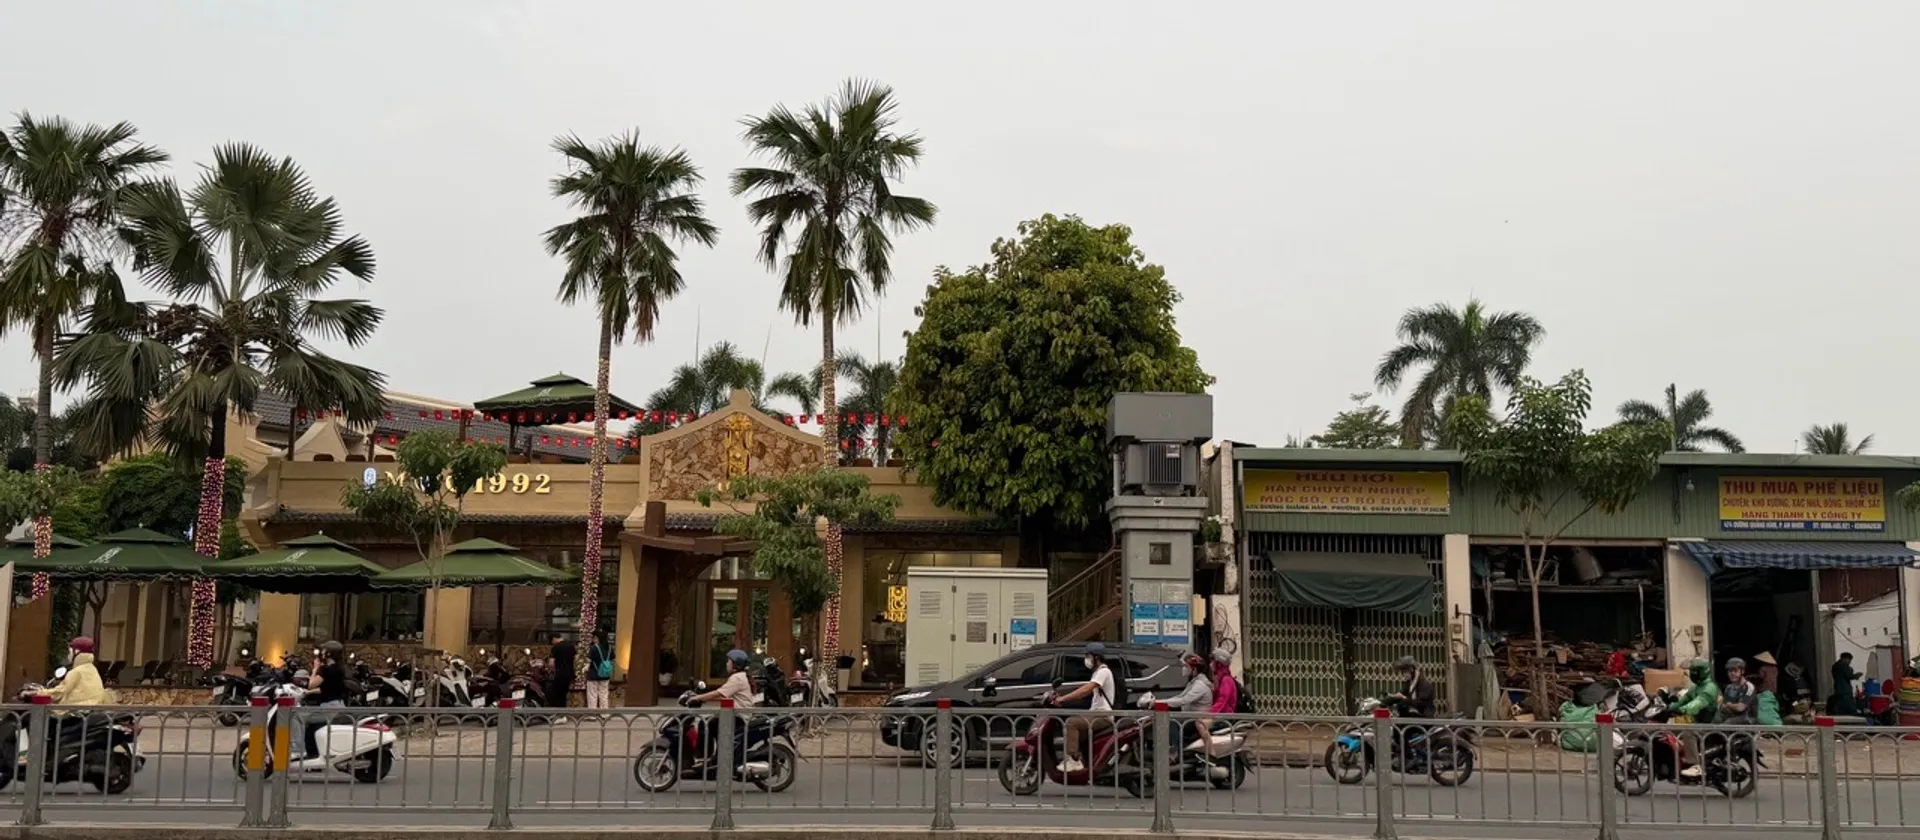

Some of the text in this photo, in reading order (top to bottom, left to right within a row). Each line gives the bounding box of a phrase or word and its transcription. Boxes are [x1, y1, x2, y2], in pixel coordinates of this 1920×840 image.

[474, 473, 551, 494] 1992
[1723, 479, 1879, 498] THU MUA PHẾ LIỆU
